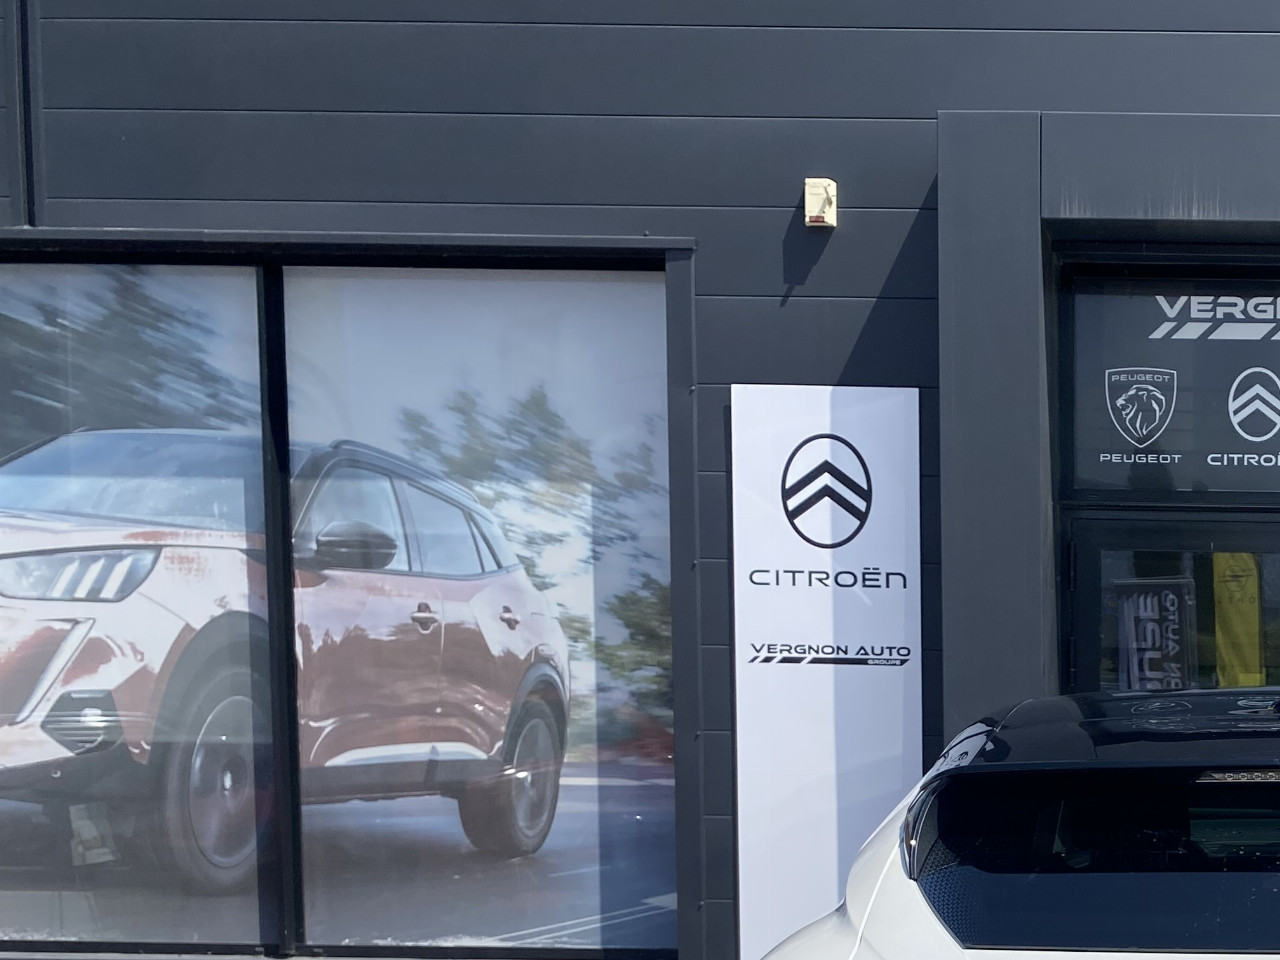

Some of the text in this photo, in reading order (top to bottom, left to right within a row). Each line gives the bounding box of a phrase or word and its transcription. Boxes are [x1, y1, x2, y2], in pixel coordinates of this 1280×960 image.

[1111, 373, 1170, 383] PEUGEOT
[1100, 453, 1182, 464] PEUGEOT
[751, 643, 911, 657] VERGNON AUTO
